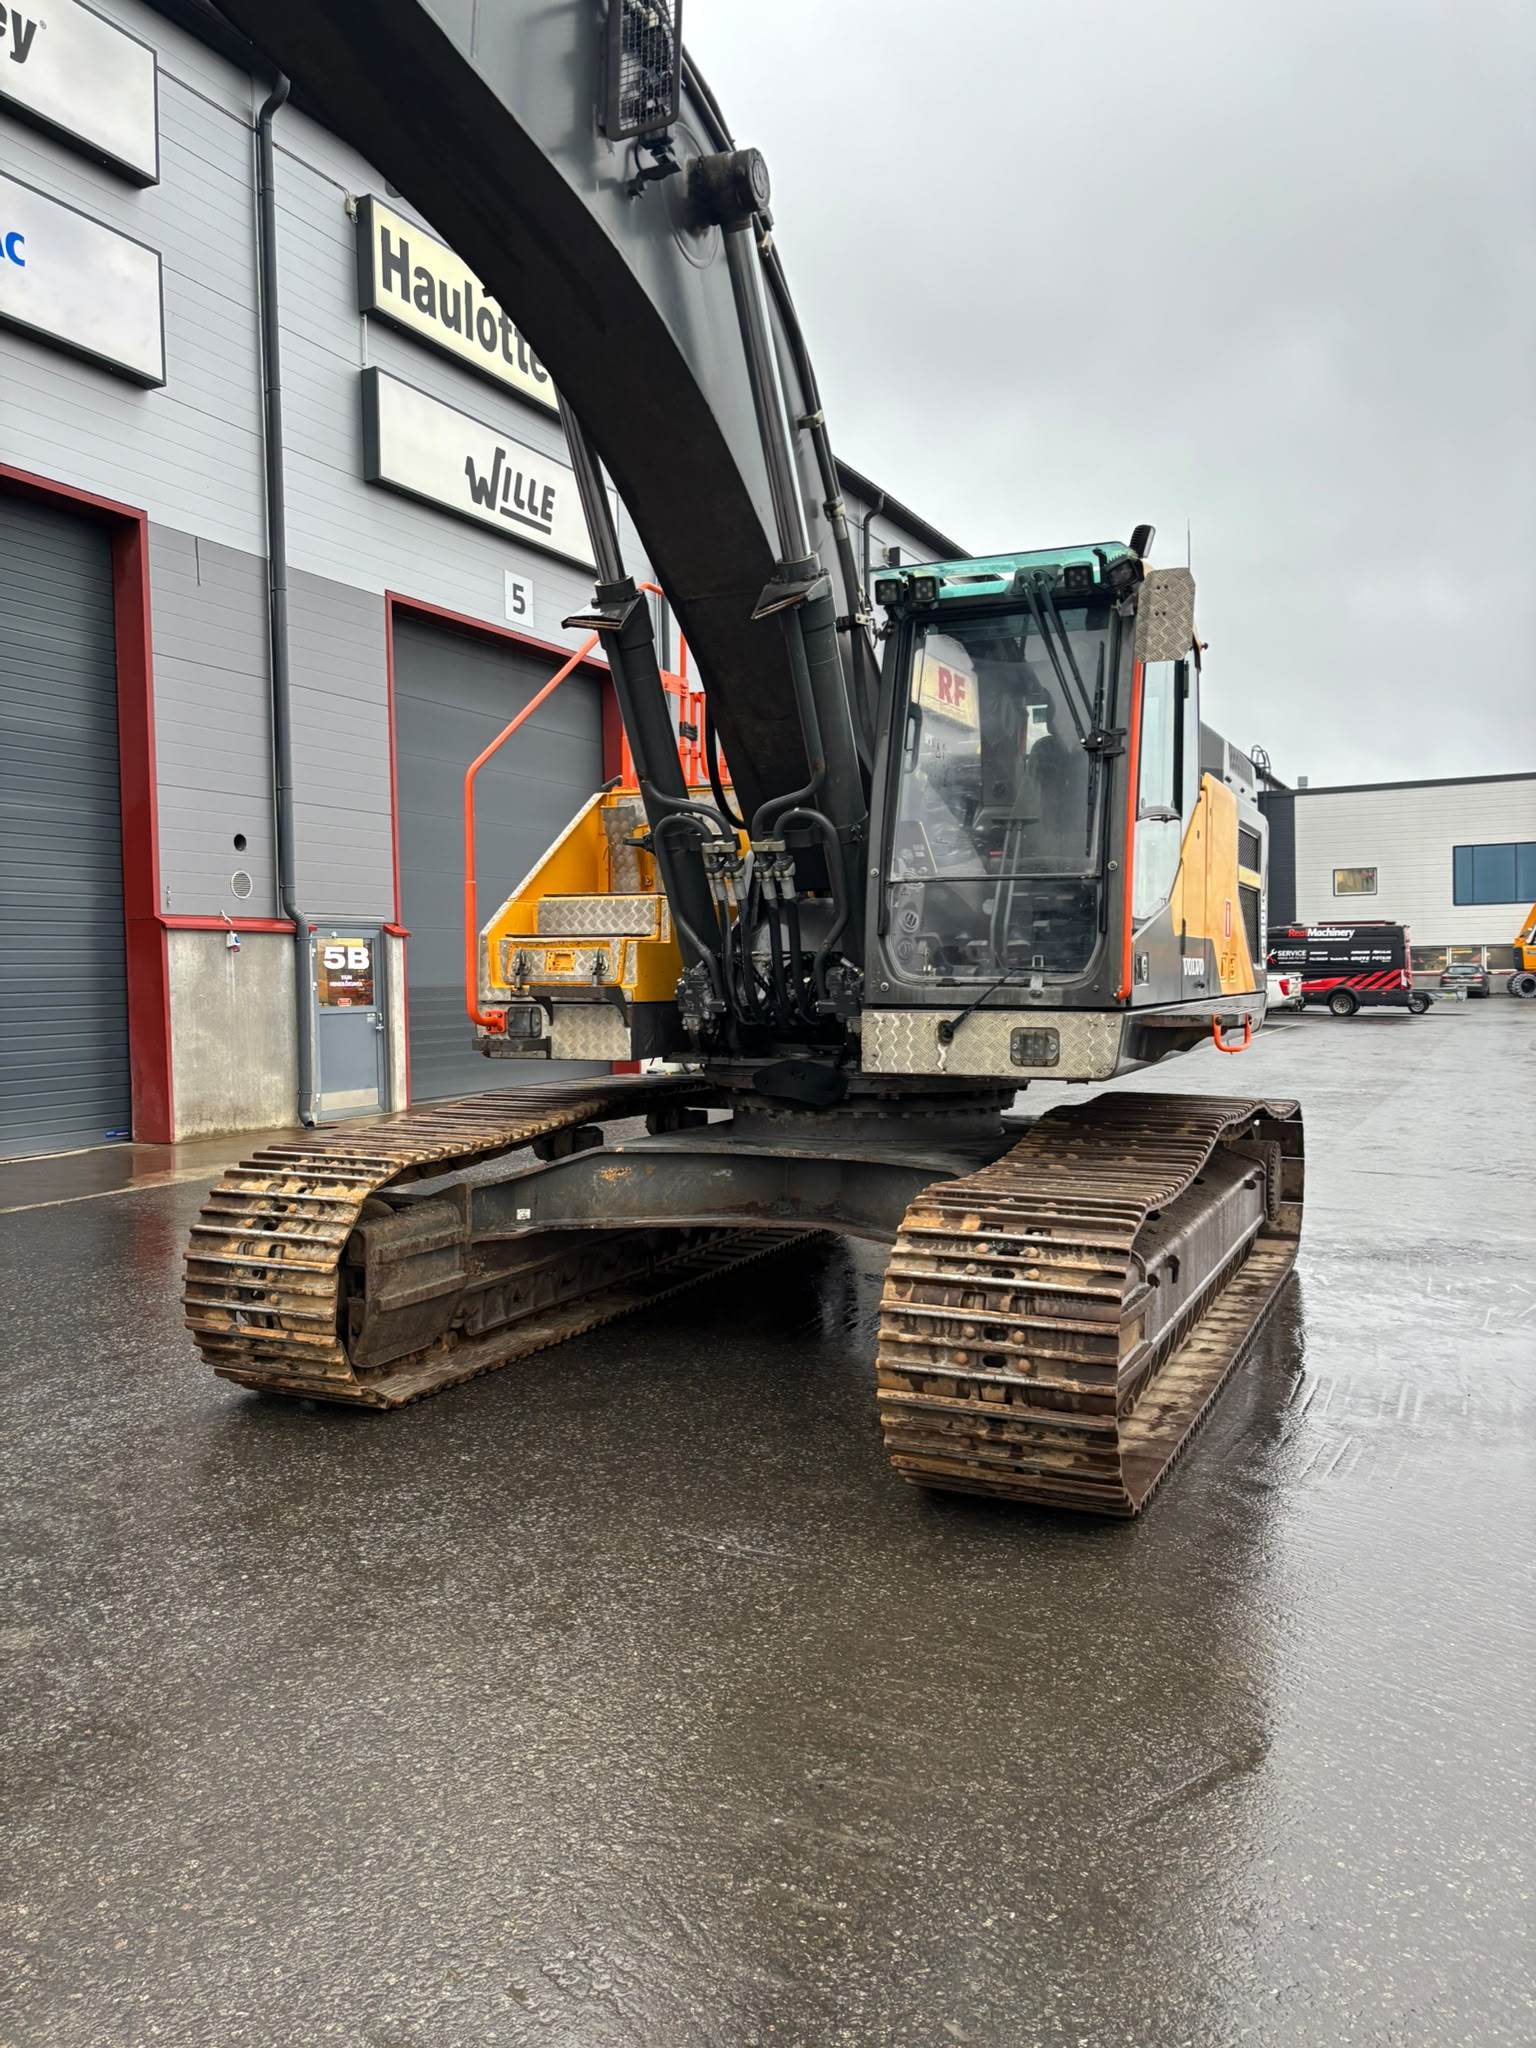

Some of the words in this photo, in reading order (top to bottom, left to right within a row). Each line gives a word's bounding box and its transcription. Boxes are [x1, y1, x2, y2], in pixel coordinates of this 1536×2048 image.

[512, 583, 526, 615] 5
[937, 665, 967, 707] RF
[323, 946, 370, 970] 5B
